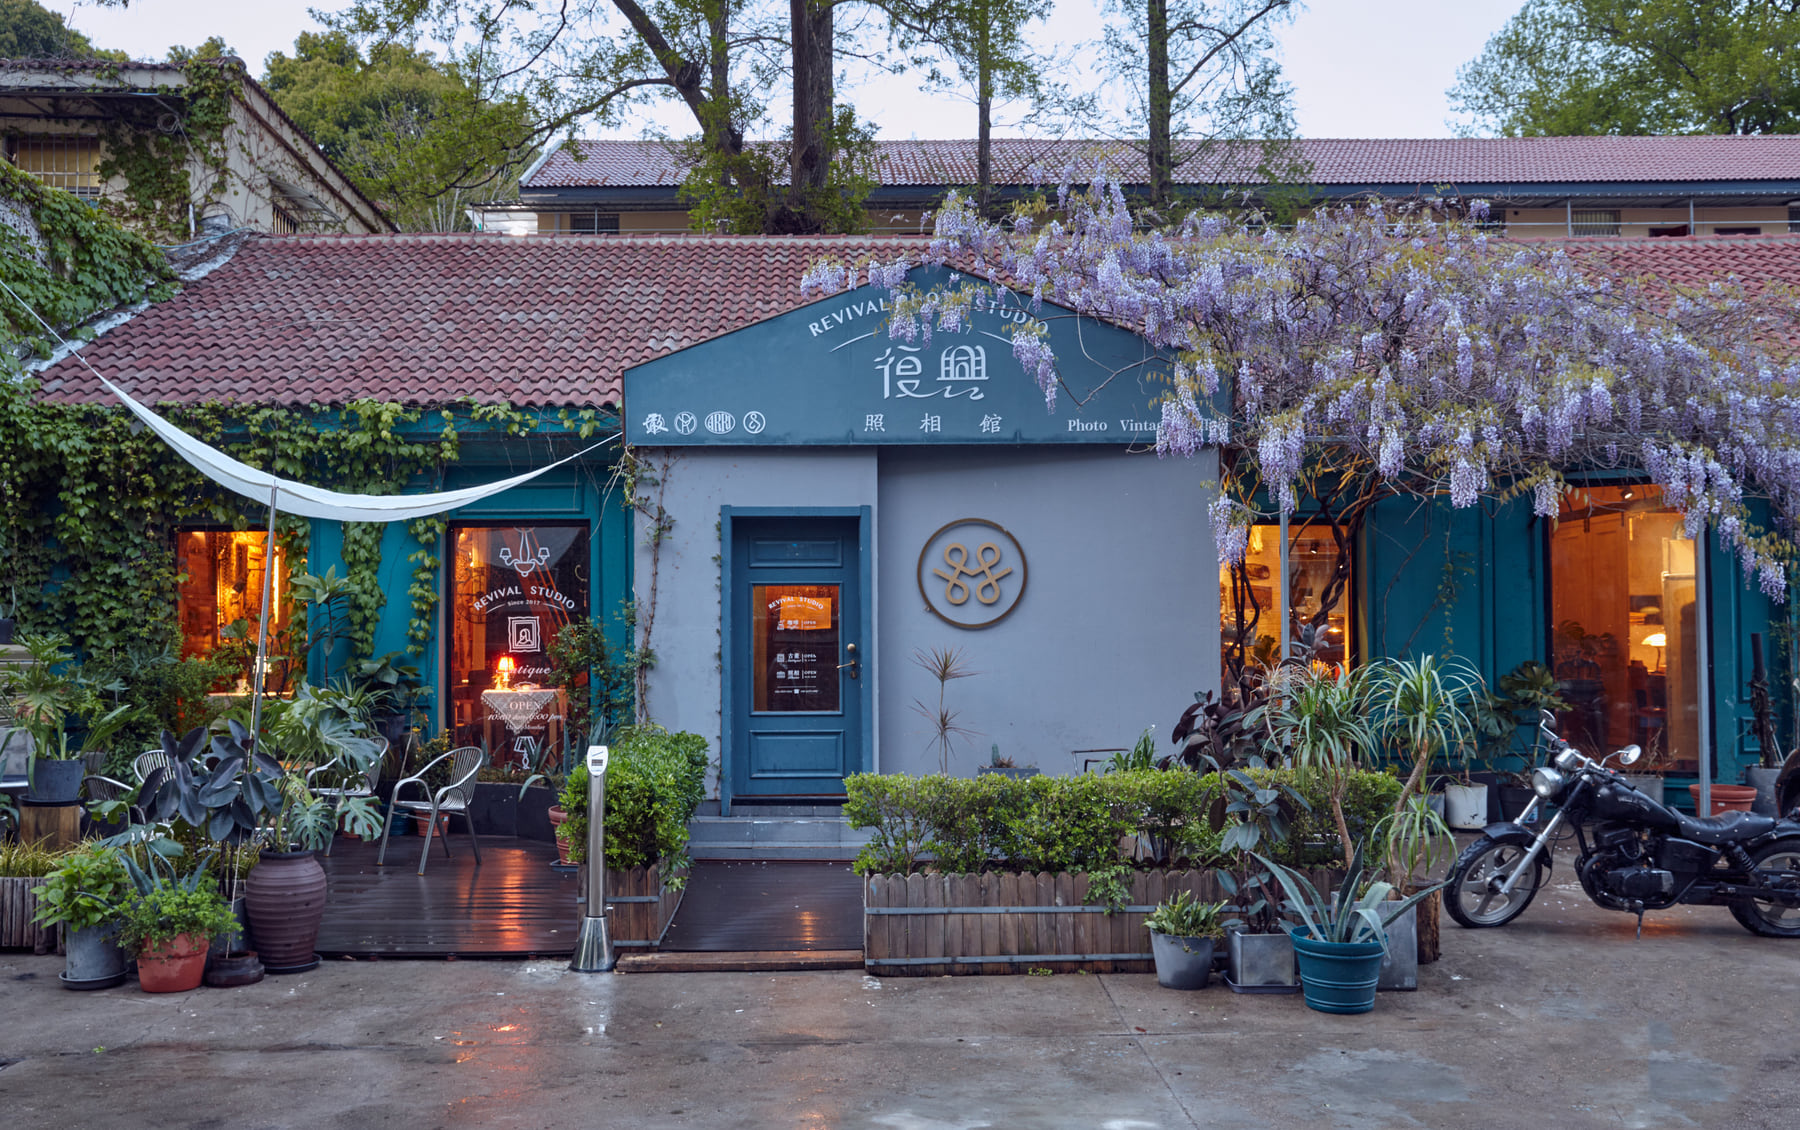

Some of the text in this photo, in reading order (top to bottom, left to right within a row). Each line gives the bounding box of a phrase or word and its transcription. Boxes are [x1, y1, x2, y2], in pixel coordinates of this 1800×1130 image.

[808, 297, 890, 337] REVIVAL
[864, 412, 1003, 434] 照相館
[1067, 418, 1108, 432] Photo
[1119, 418, 1166, 433] Vinta
[472, 585, 576, 611] REVIVAL STUDIO
[768, 596, 824, 610] REVIVAL STUDIO
